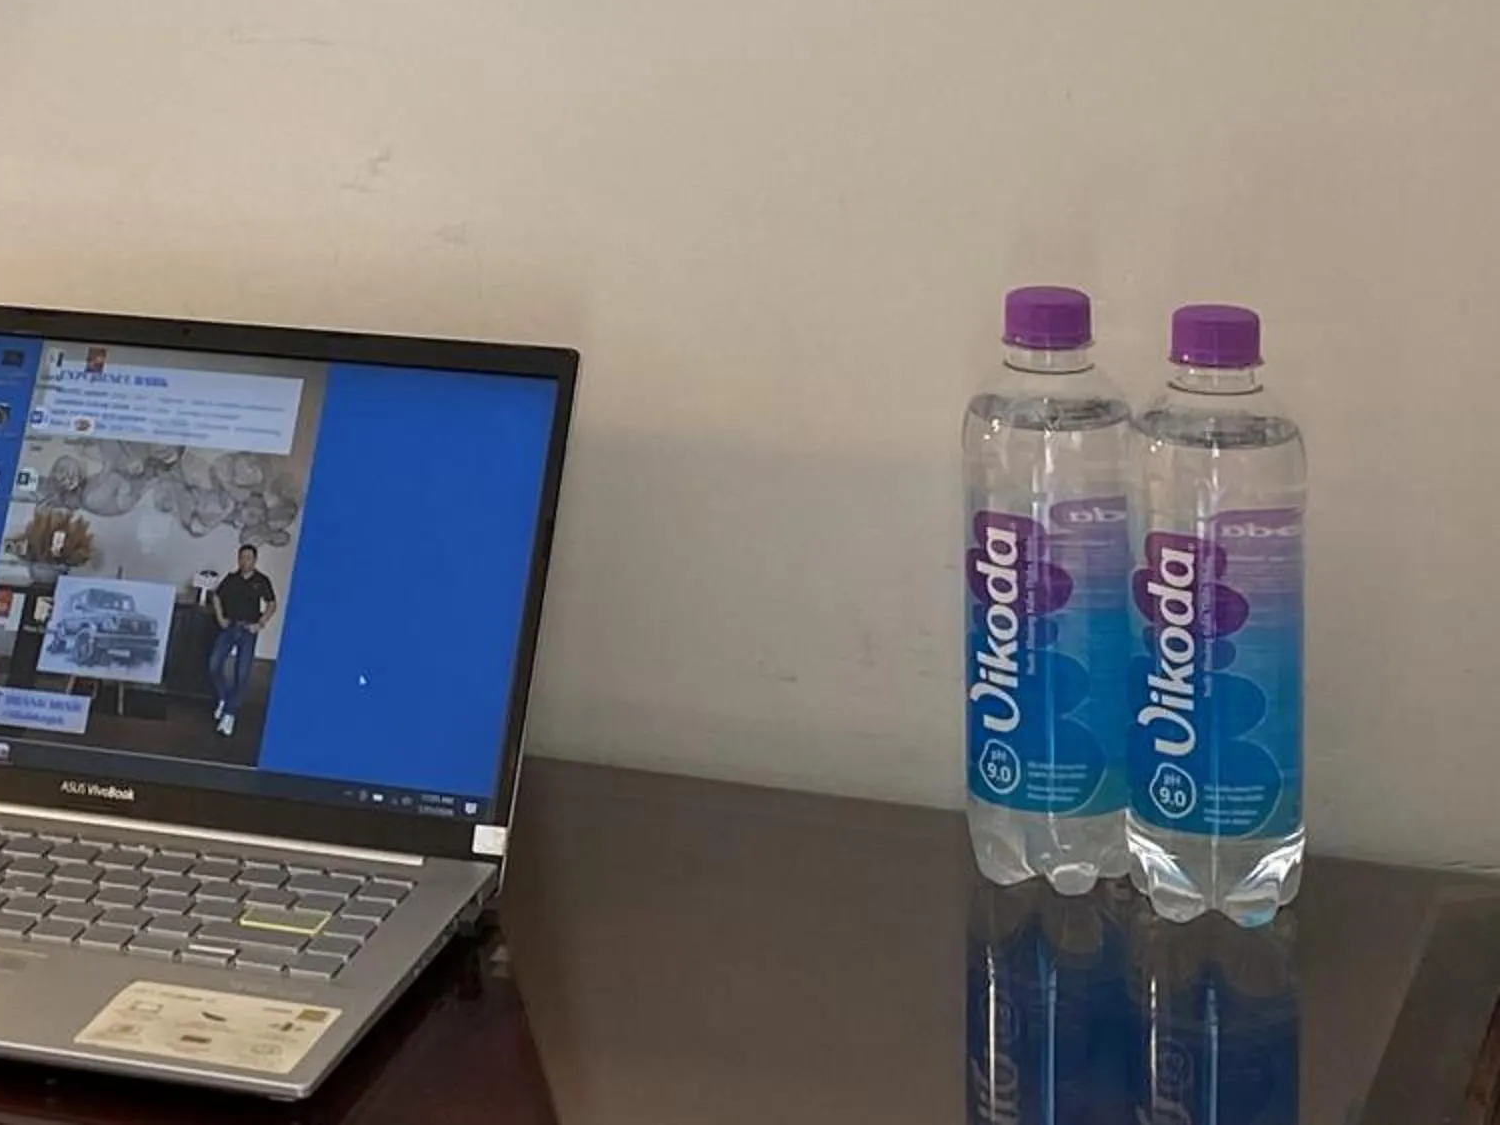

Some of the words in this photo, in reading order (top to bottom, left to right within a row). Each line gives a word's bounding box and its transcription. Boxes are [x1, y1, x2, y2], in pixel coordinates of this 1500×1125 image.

[986, 762, 1011, 783] 9.0
[60, 780, 87, 796] ASUS
[1159, 786, 1187, 808] 9.0
